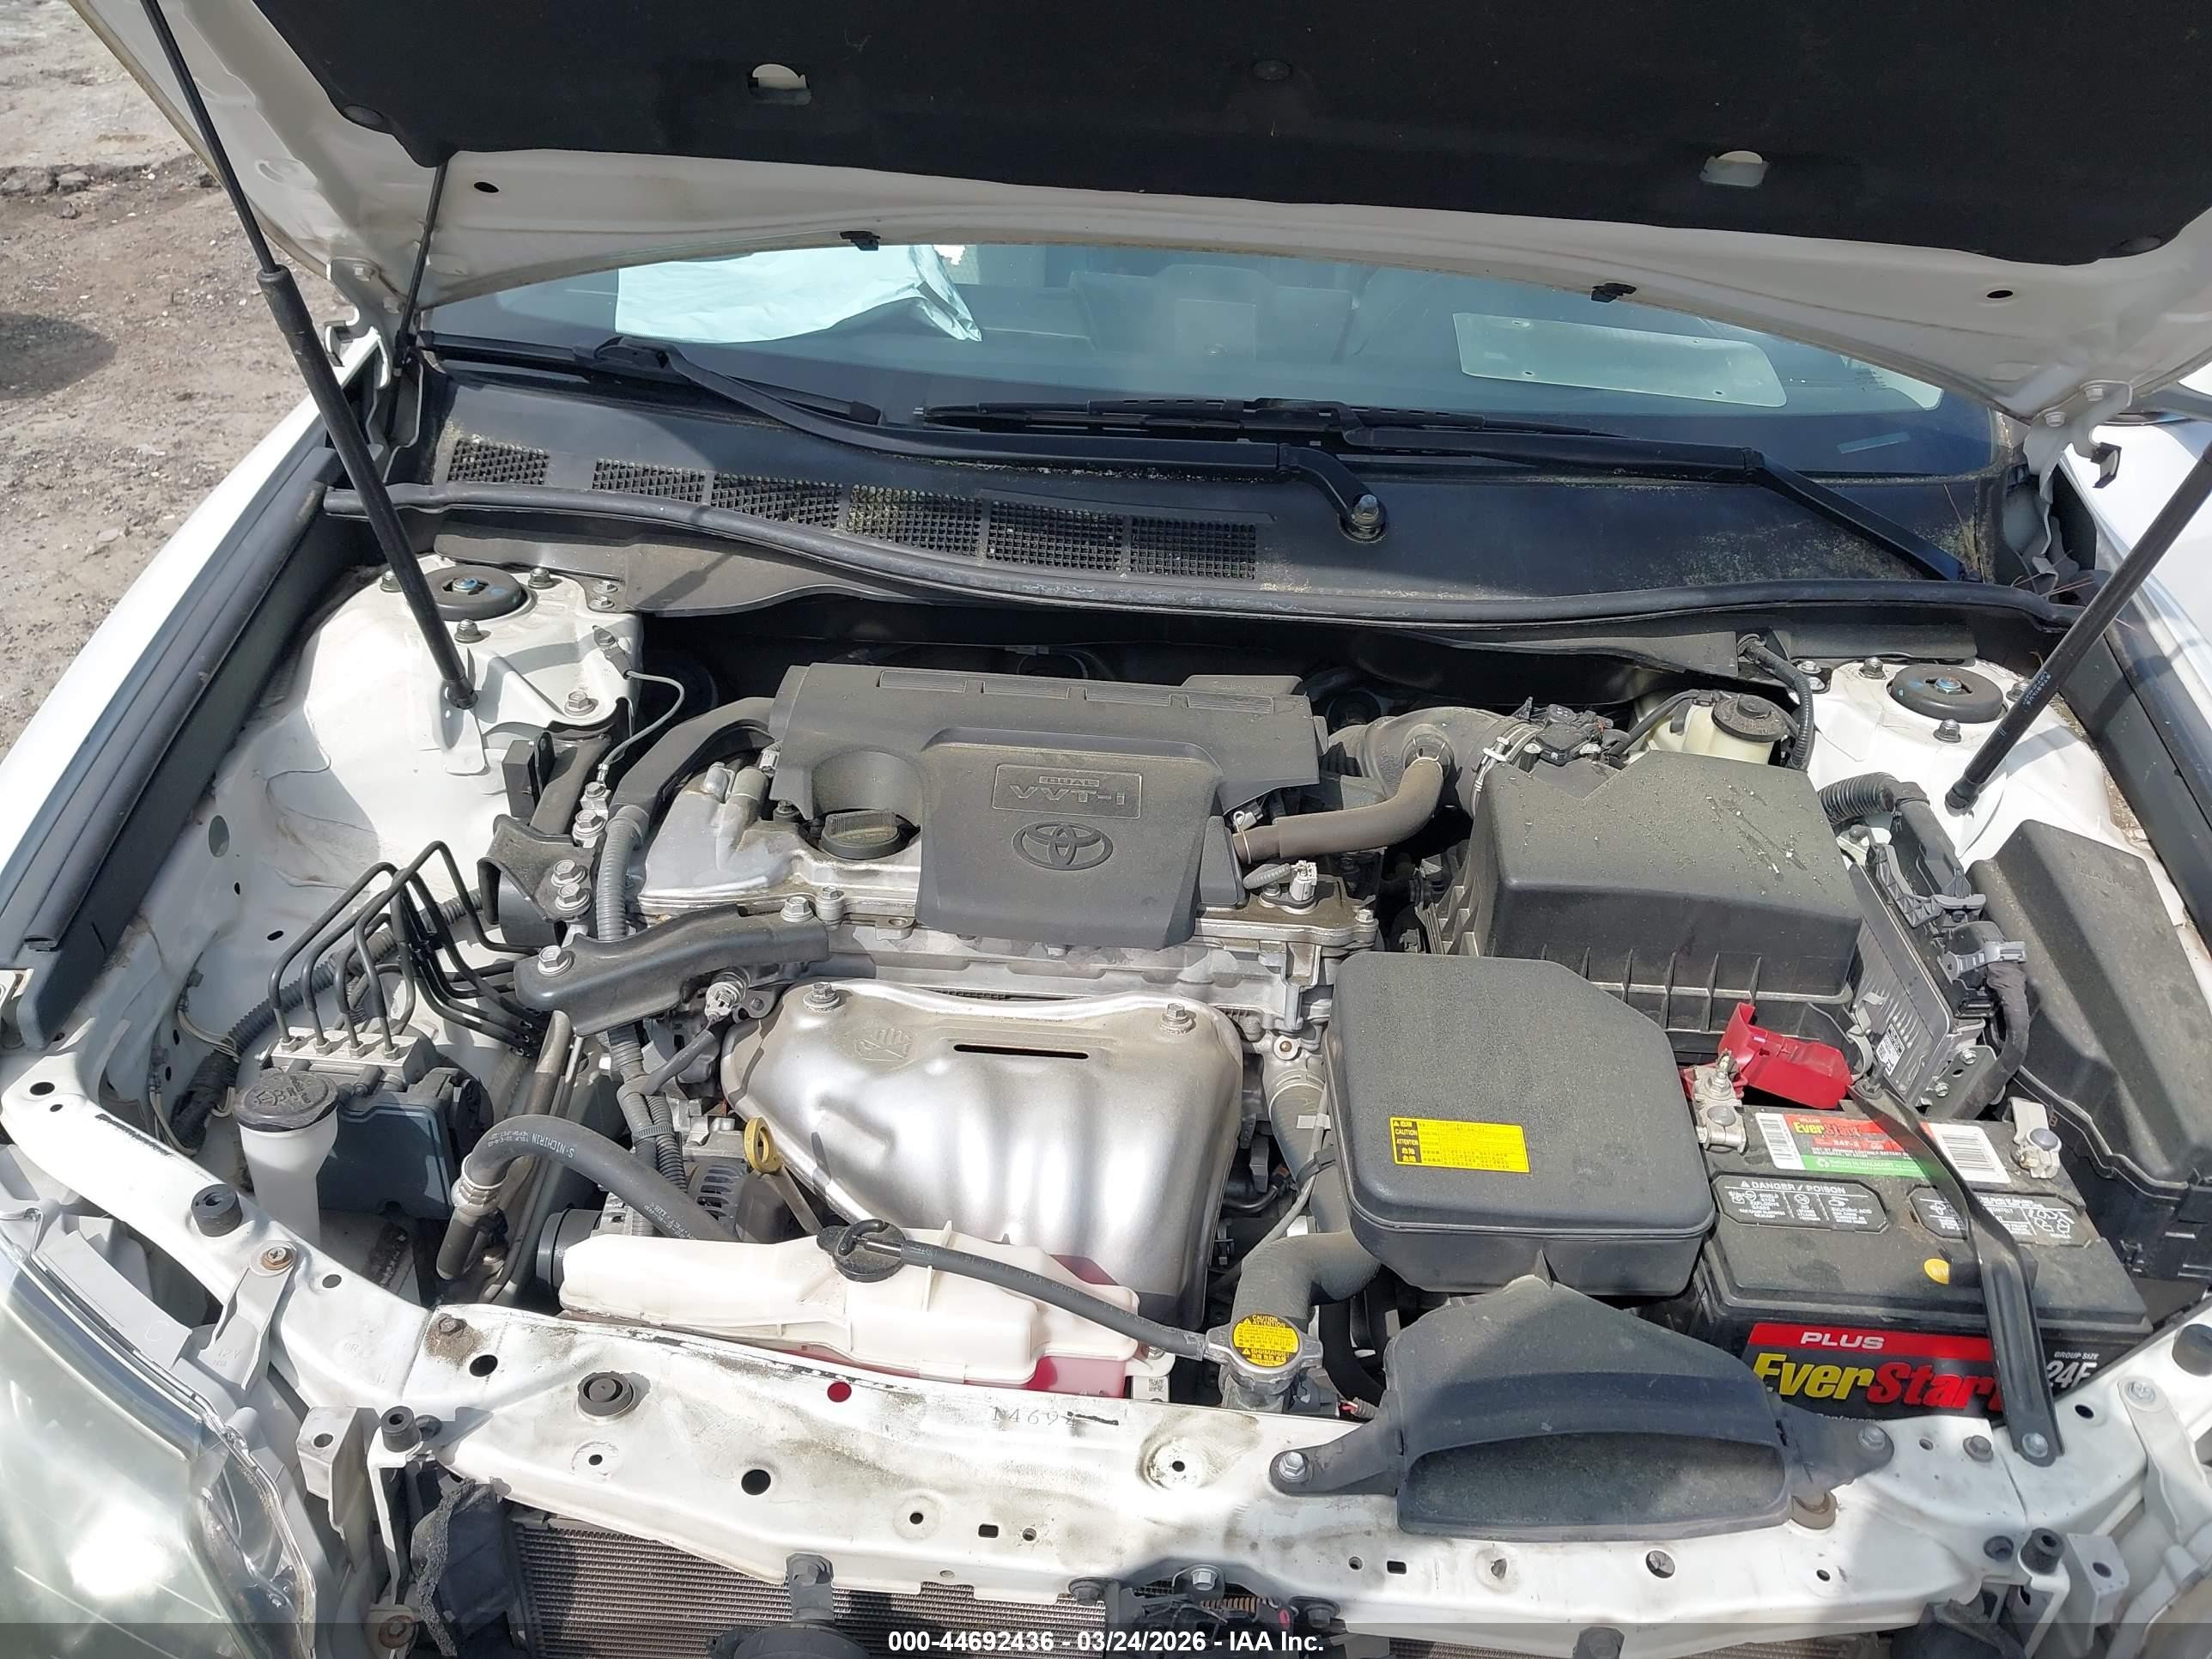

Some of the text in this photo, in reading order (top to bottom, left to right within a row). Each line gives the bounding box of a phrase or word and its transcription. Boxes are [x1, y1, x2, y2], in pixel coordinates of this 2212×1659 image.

[1751, 1181, 1796, 1192] DANGER
[1806, 1185, 1846, 1194] POISON
[1252, 1320, 1286, 1328] ATTENTION
[1800, 1331, 1886, 1350] PLUS
[2054, 1351, 2100, 1360] GROUP SIZE
